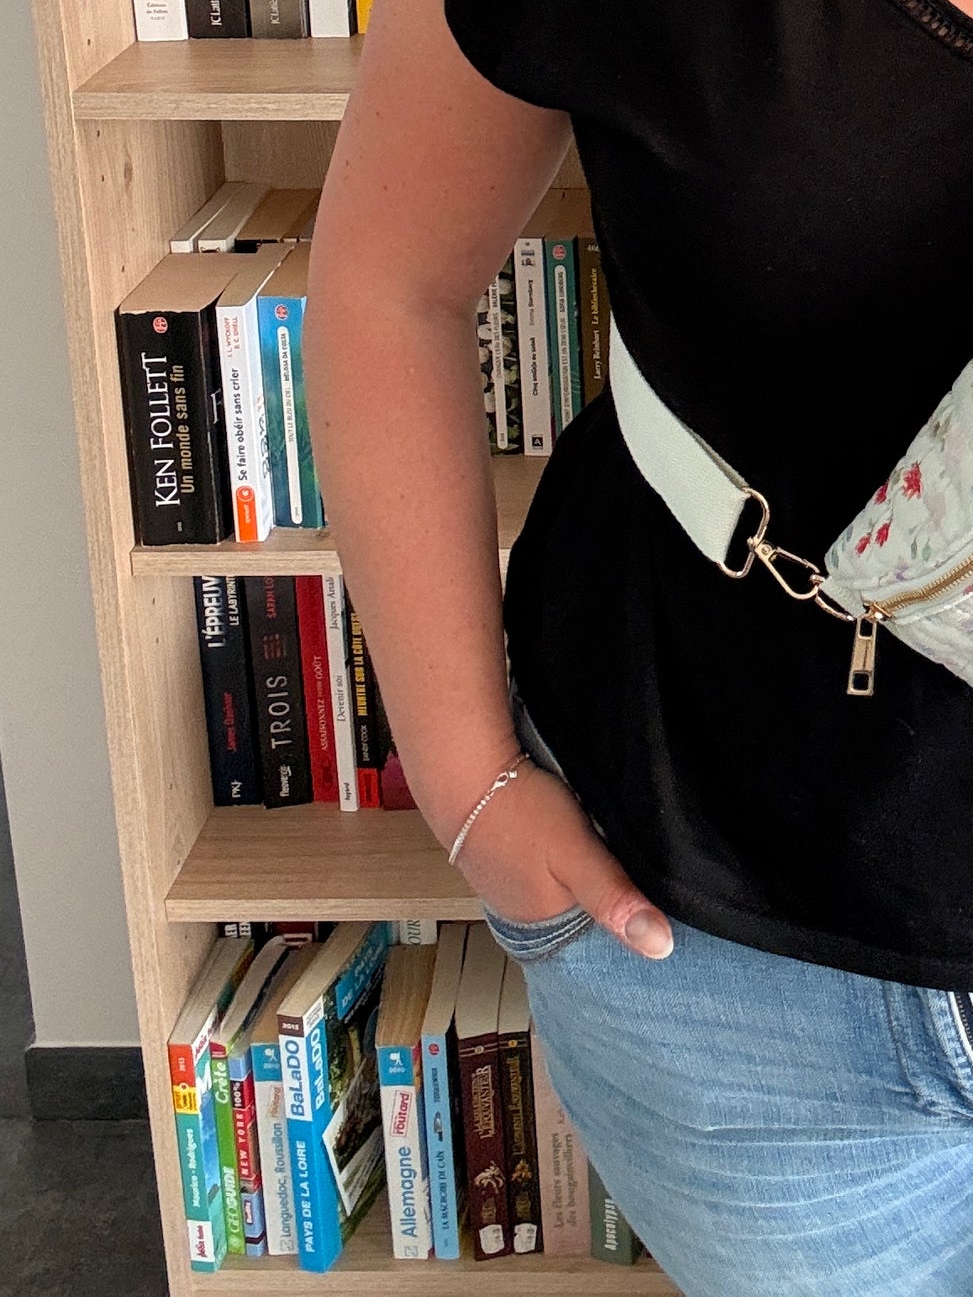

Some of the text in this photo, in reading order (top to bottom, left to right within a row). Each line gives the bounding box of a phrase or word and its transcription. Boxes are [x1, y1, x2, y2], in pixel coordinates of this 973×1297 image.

[141, 352, 180, 507] KEN FOLLETT
[171, 366, 195, 493] Un monde sans fin
[230, 368, 248, 480] Se obéir sans crier
[266, 676, 292, 749] TROIS
[355, 667, 365, 682] SUR
[213, 1062, 230, 1103] Crète
[232, 1082, 242, 1107] 100%
[285, 1040, 305, 1117] BaLaDO
[394, 1092, 410, 1135] routard
[235, 1113, 249, 1175] NEW YORK
[271, 1123, 292, 1238] Languedoc, Roussillon
[295, 1140, 315, 1253] PAYS DE LA LOIRE
[398, 1147, 417, 1238] Allemagne
